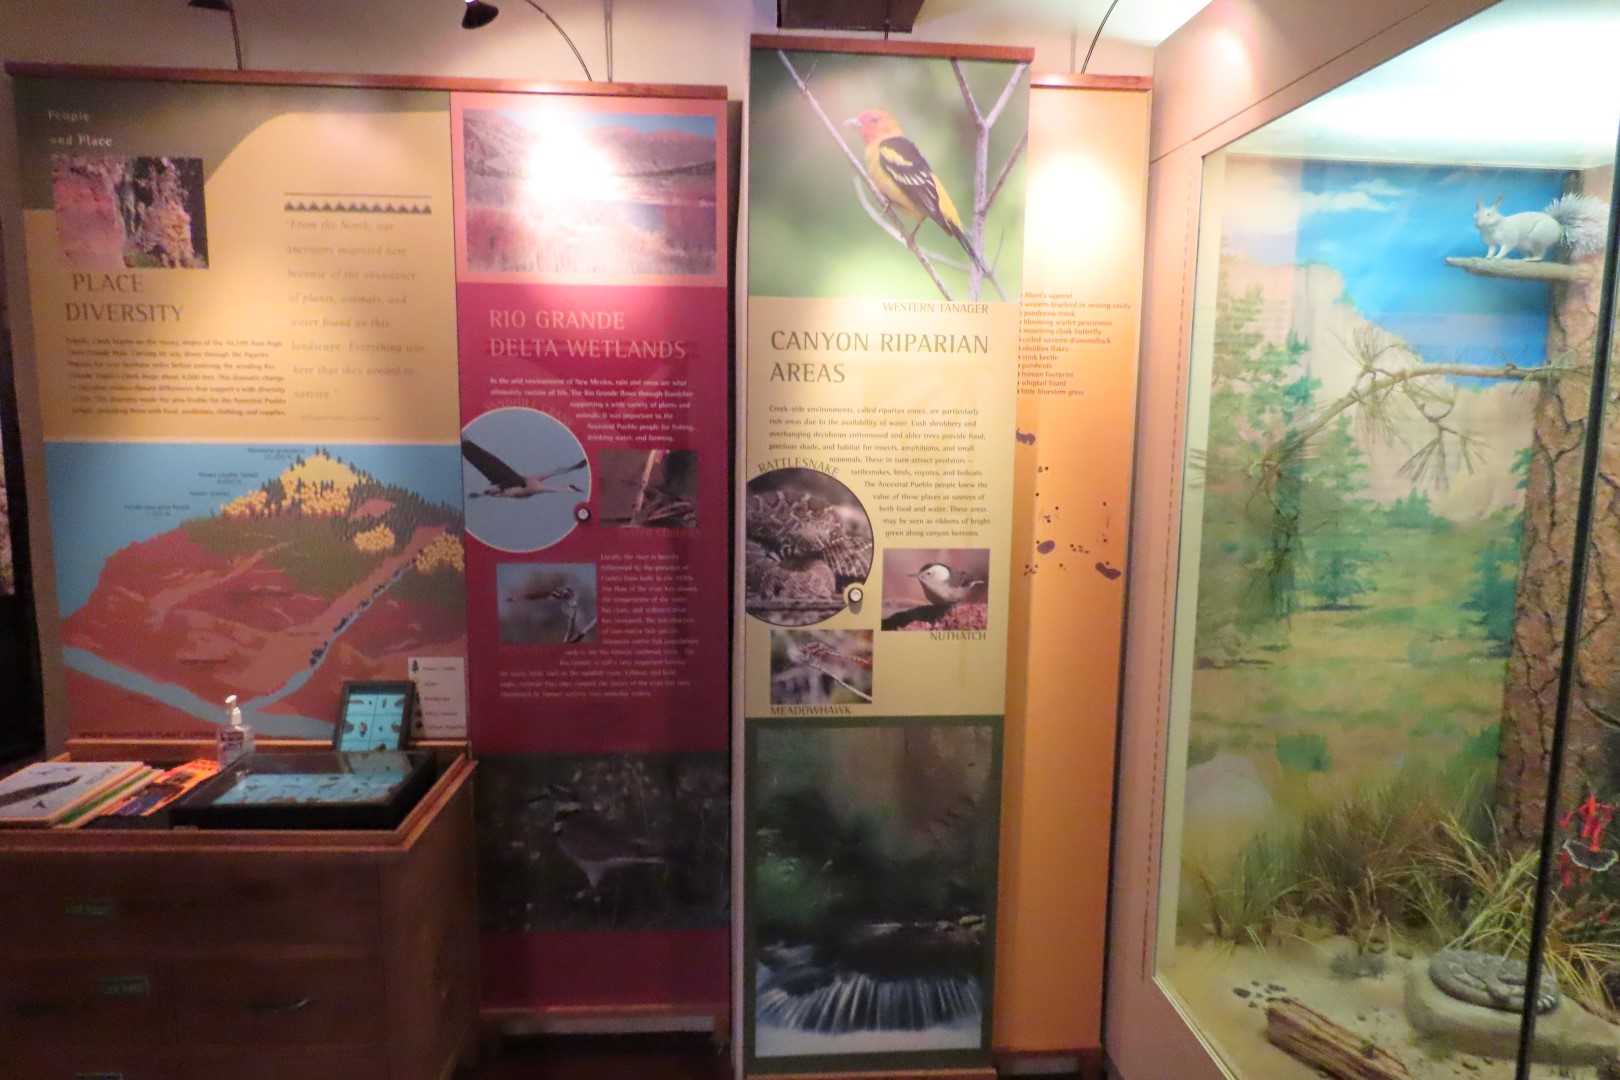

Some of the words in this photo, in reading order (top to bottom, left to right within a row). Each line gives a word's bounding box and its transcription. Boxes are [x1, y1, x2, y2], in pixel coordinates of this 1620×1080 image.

[78, 134, 112, 146] Place
[73, 273, 143, 292] PLACE
[65, 303, 183, 321] DIVERSITY
[883, 302, 935, 313] WESTERN
[939, 303, 988, 314] TANAGER
[490, 310, 526, 328] RIO
[536, 311, 625, 330] GRANDE
[771, 330, 869, 352] CANYON
[880, 333, 988, 354] RIPARIAN
[491, 338, 558, 357] DELTA
[567, 340, 686, 359] WETLANDS
[770, 363, 845, 383] AREAS
[878, 407, 904, 416] riparian
[941, 407, 979, 416] particularly
[841, 418, 876, 427] availability
[769, 430, 810, 440] overhanging
[848, 431, 888, 439] cottonwood
[941, 432, 966, 441] provide
[968, 433, 986, 441] food,
[769, 444, 796, 452] precious
[799, 443, 820, 451] shade,
[957, 444, 974, 452] small
[758, 457, 839, 476] RATTLESNAKE
[850, 468, 892, 476] rattlesnakes,
[914, 469, 940, 477] coyotes,
[934, 481, 955, 490] people
[920, 493, 940, 502] places
[970, 517, 990, 526] bright
[905, 529, 923, 538] along
[930, 632, 986, 641] NUTHATCH
[770, 706, 851, 715] MEADOWHAWK
